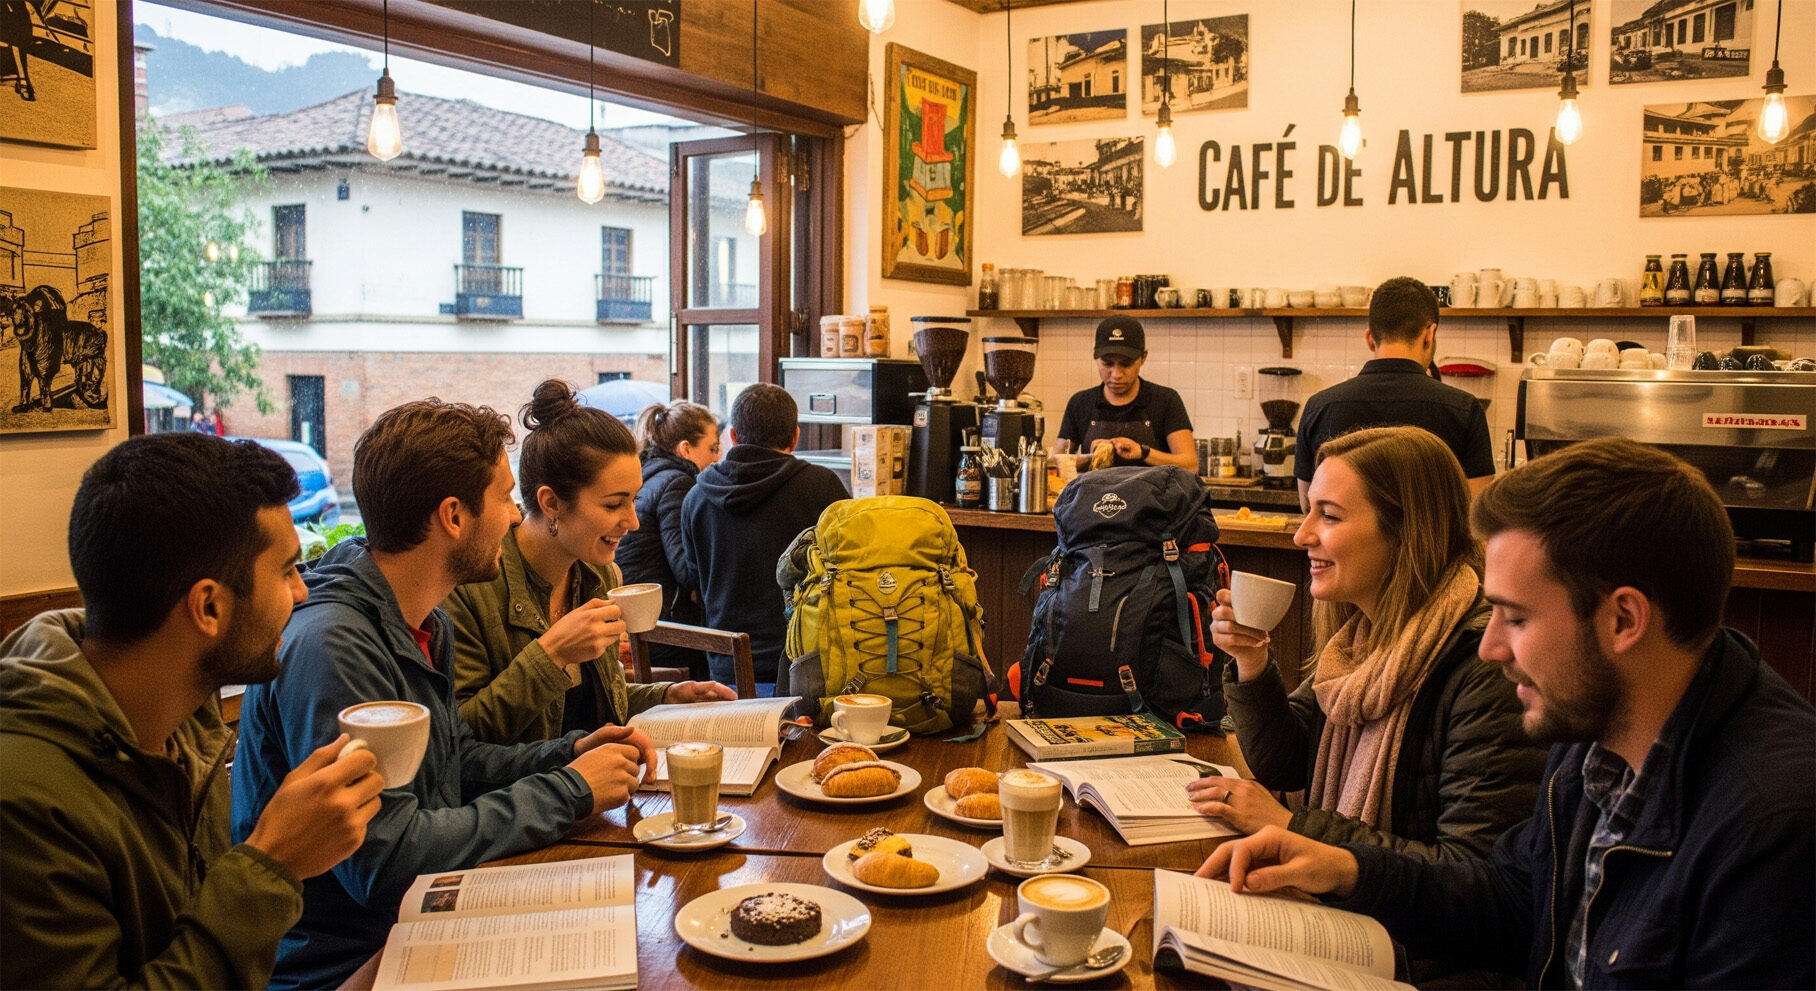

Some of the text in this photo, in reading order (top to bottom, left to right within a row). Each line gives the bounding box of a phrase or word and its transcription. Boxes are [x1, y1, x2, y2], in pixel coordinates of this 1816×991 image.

[1198, 123, 1570, 212] CAFÉ DE ALTURA
